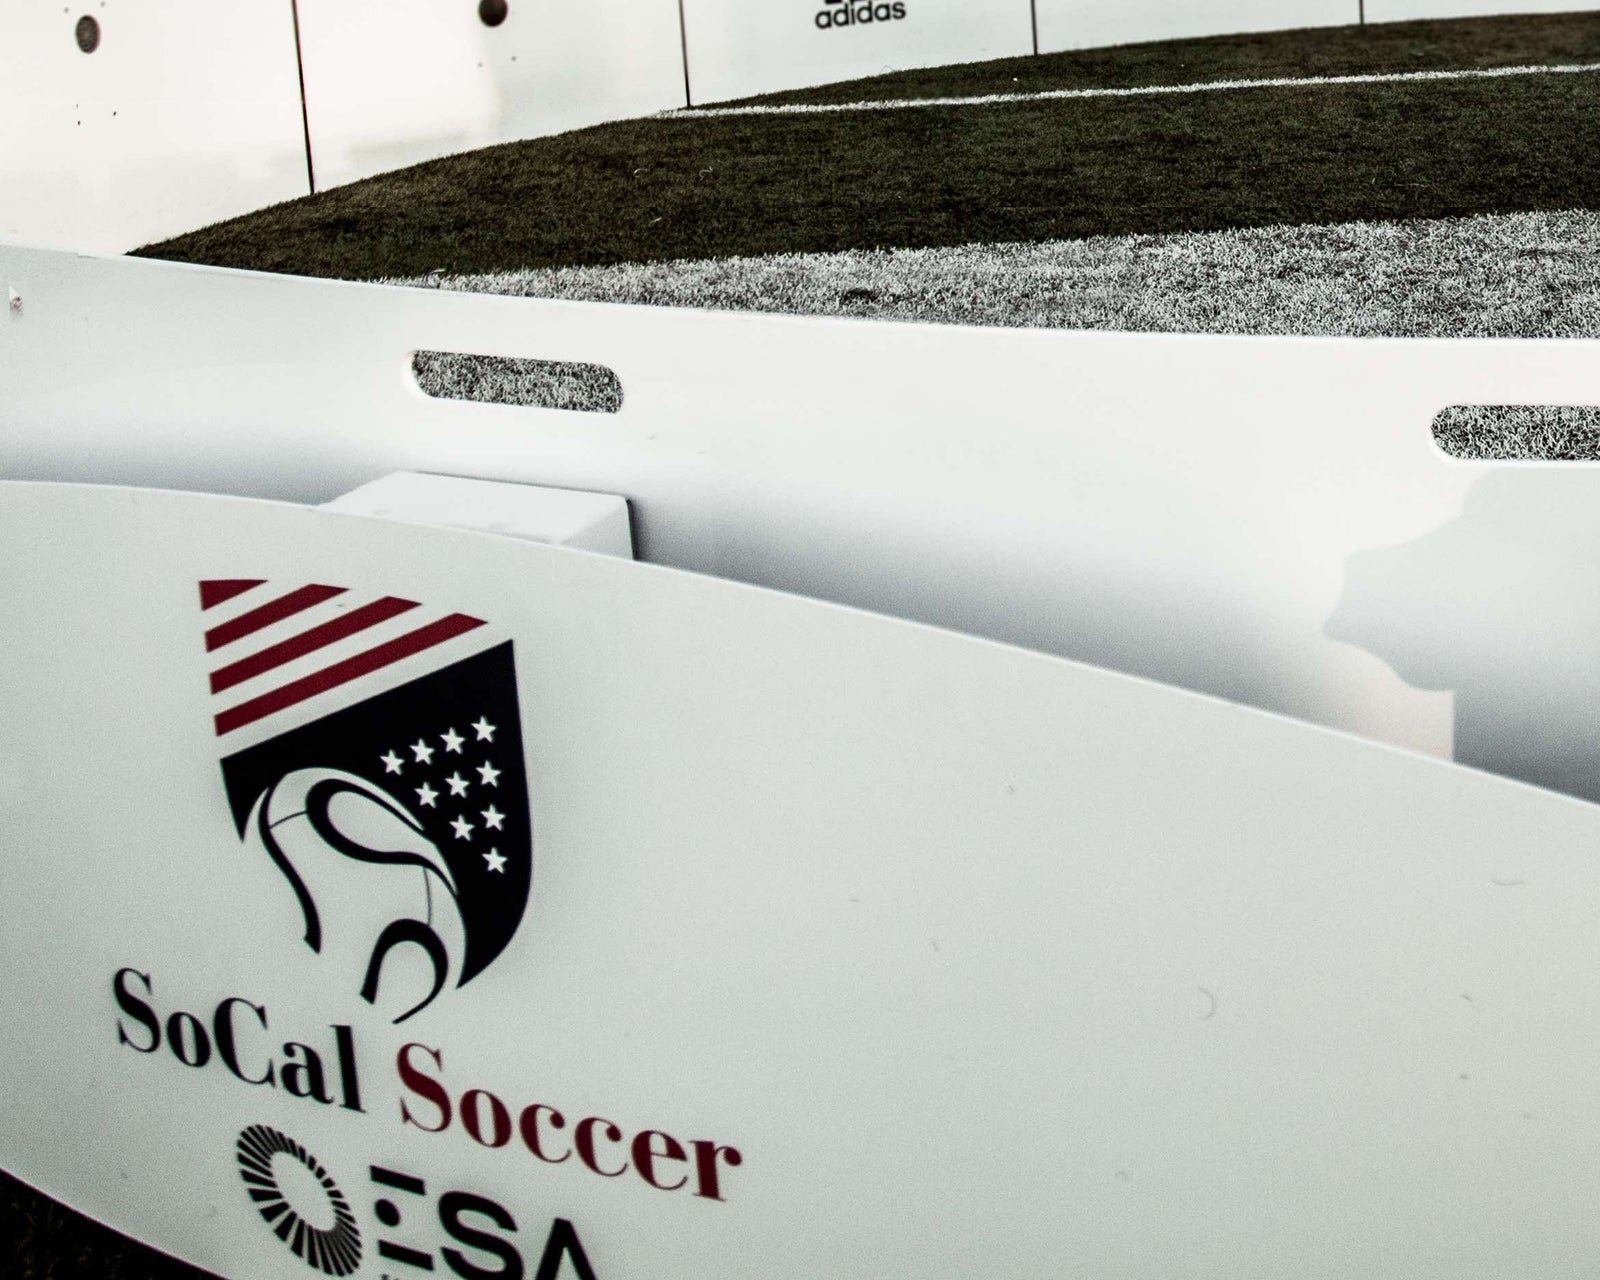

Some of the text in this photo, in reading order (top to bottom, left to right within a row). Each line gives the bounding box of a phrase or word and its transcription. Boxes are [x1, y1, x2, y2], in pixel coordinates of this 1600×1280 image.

[814, 0, 907, 30] adidas
[112, 967, 743, 1203] SoCal Soccer
